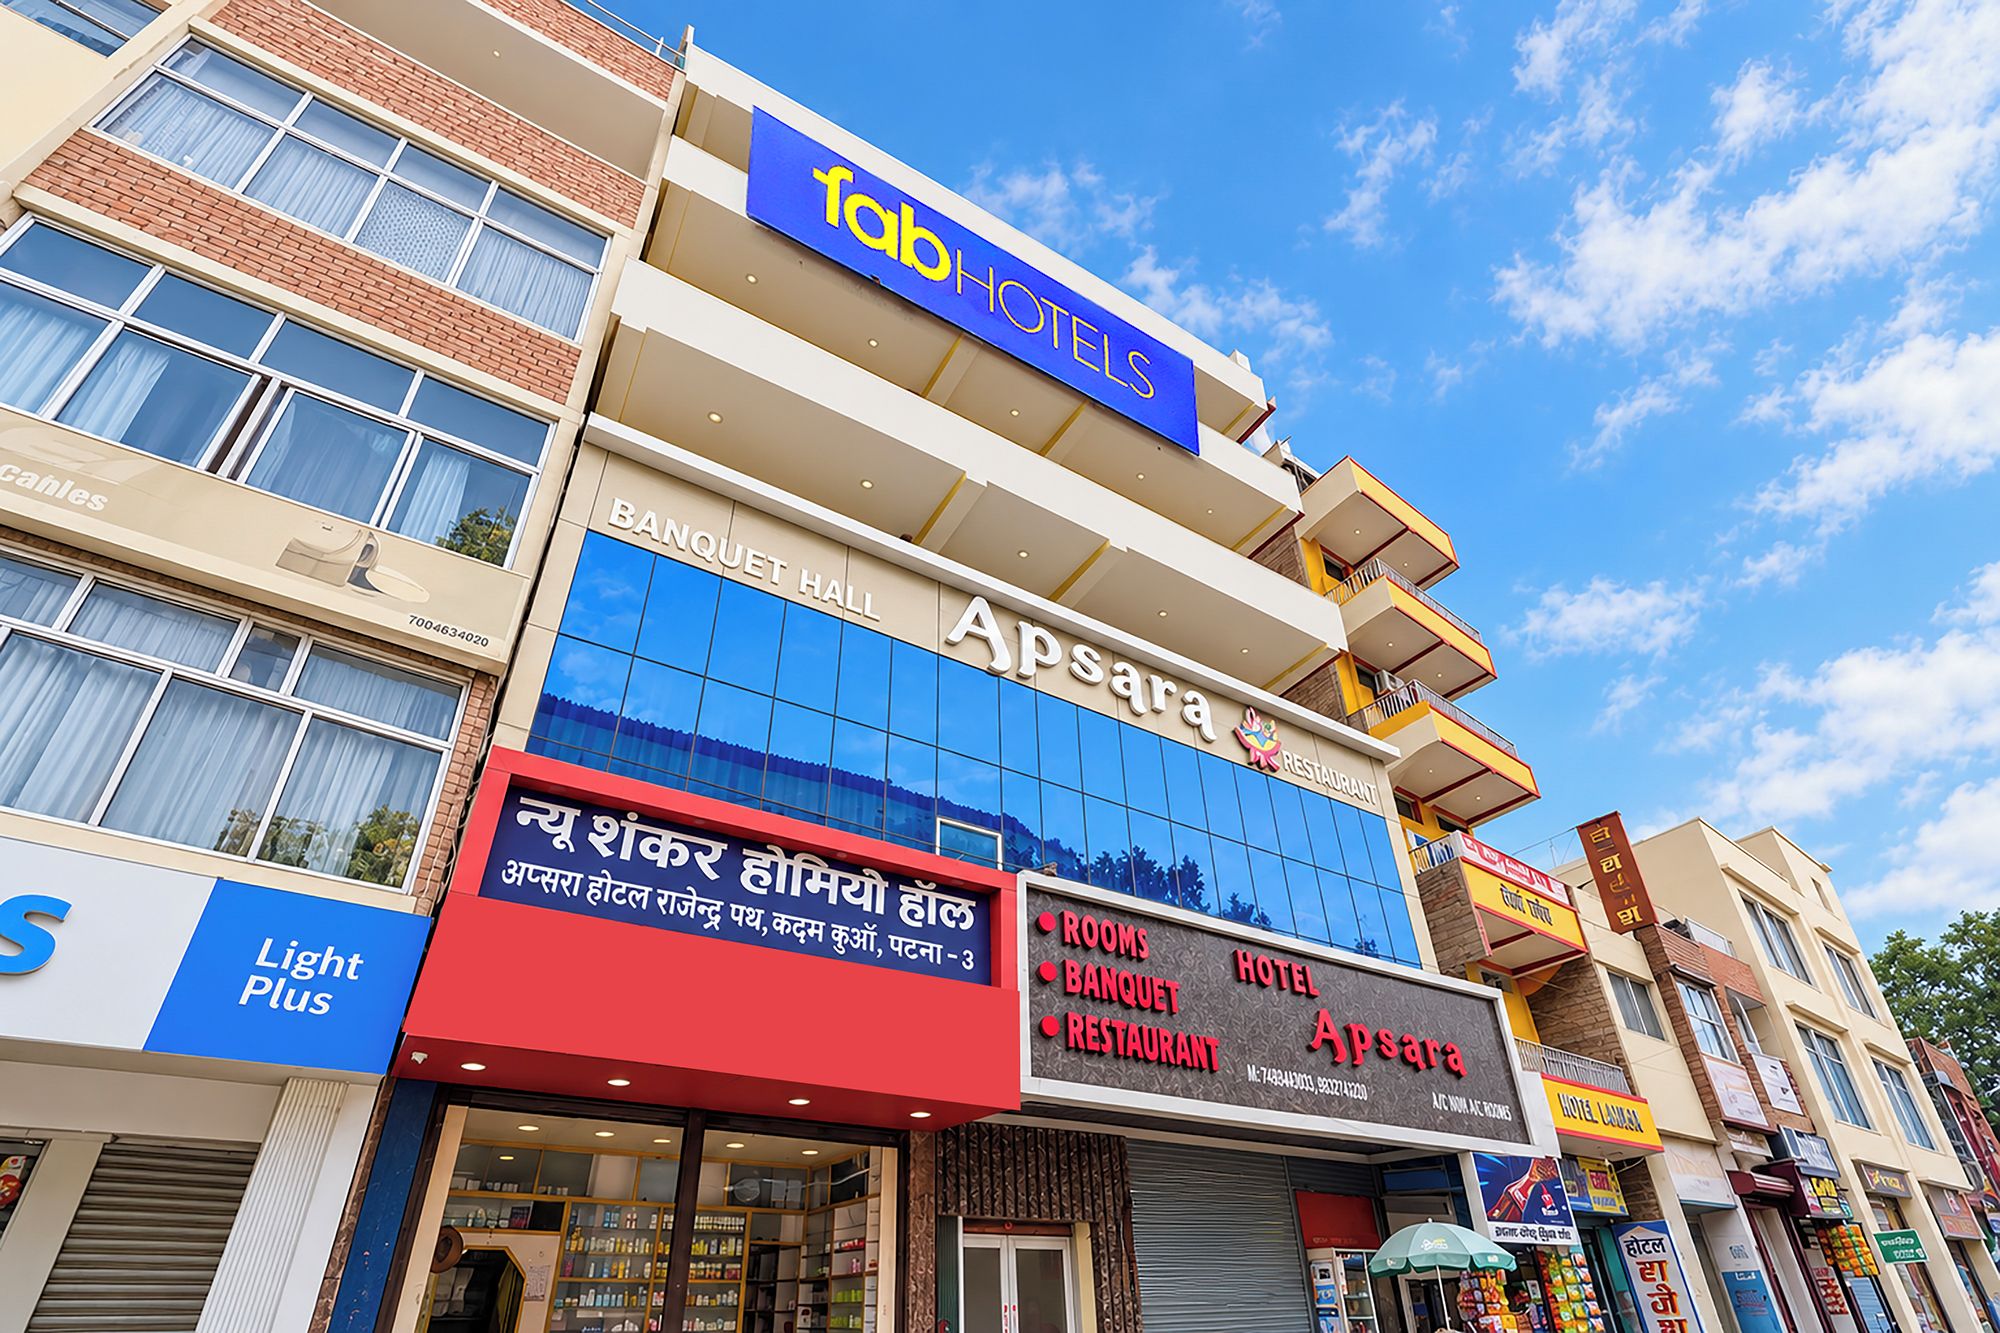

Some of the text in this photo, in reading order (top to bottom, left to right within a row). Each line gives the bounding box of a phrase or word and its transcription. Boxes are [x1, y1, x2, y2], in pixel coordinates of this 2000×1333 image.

[608, 497, 881, 621] BANQUET HALL
[408, 614, 490, 648] 7004634020
[945, 595, 1218, 743] Apsara
[1281, 750, 1377, 805] RESTAURANT
[516, 796, 976, 930] न्यू शंकर होमियो हॉल
[501, 859, 584, 897] अप्सरा
[586, 869, 653, 910] होटल
[656, 885, 724, 931] राजेन्द्र
[772, 911, 826, 944] कदम
[254, 937, 364, 982] Light
[1061, 910, 1150, 960] ROOMS
[238, 973, 334, 1016] Plus
[1063, 959, 1181, 1015] BANQUET
[1234, 949, 1321, 998] HOTEL
[1066, 1011, 1220, 1072] RESTAURANT
[1308, 1008, 1468, 1077] Apsara
[1623, 1235, 1667, 1258] होटल
